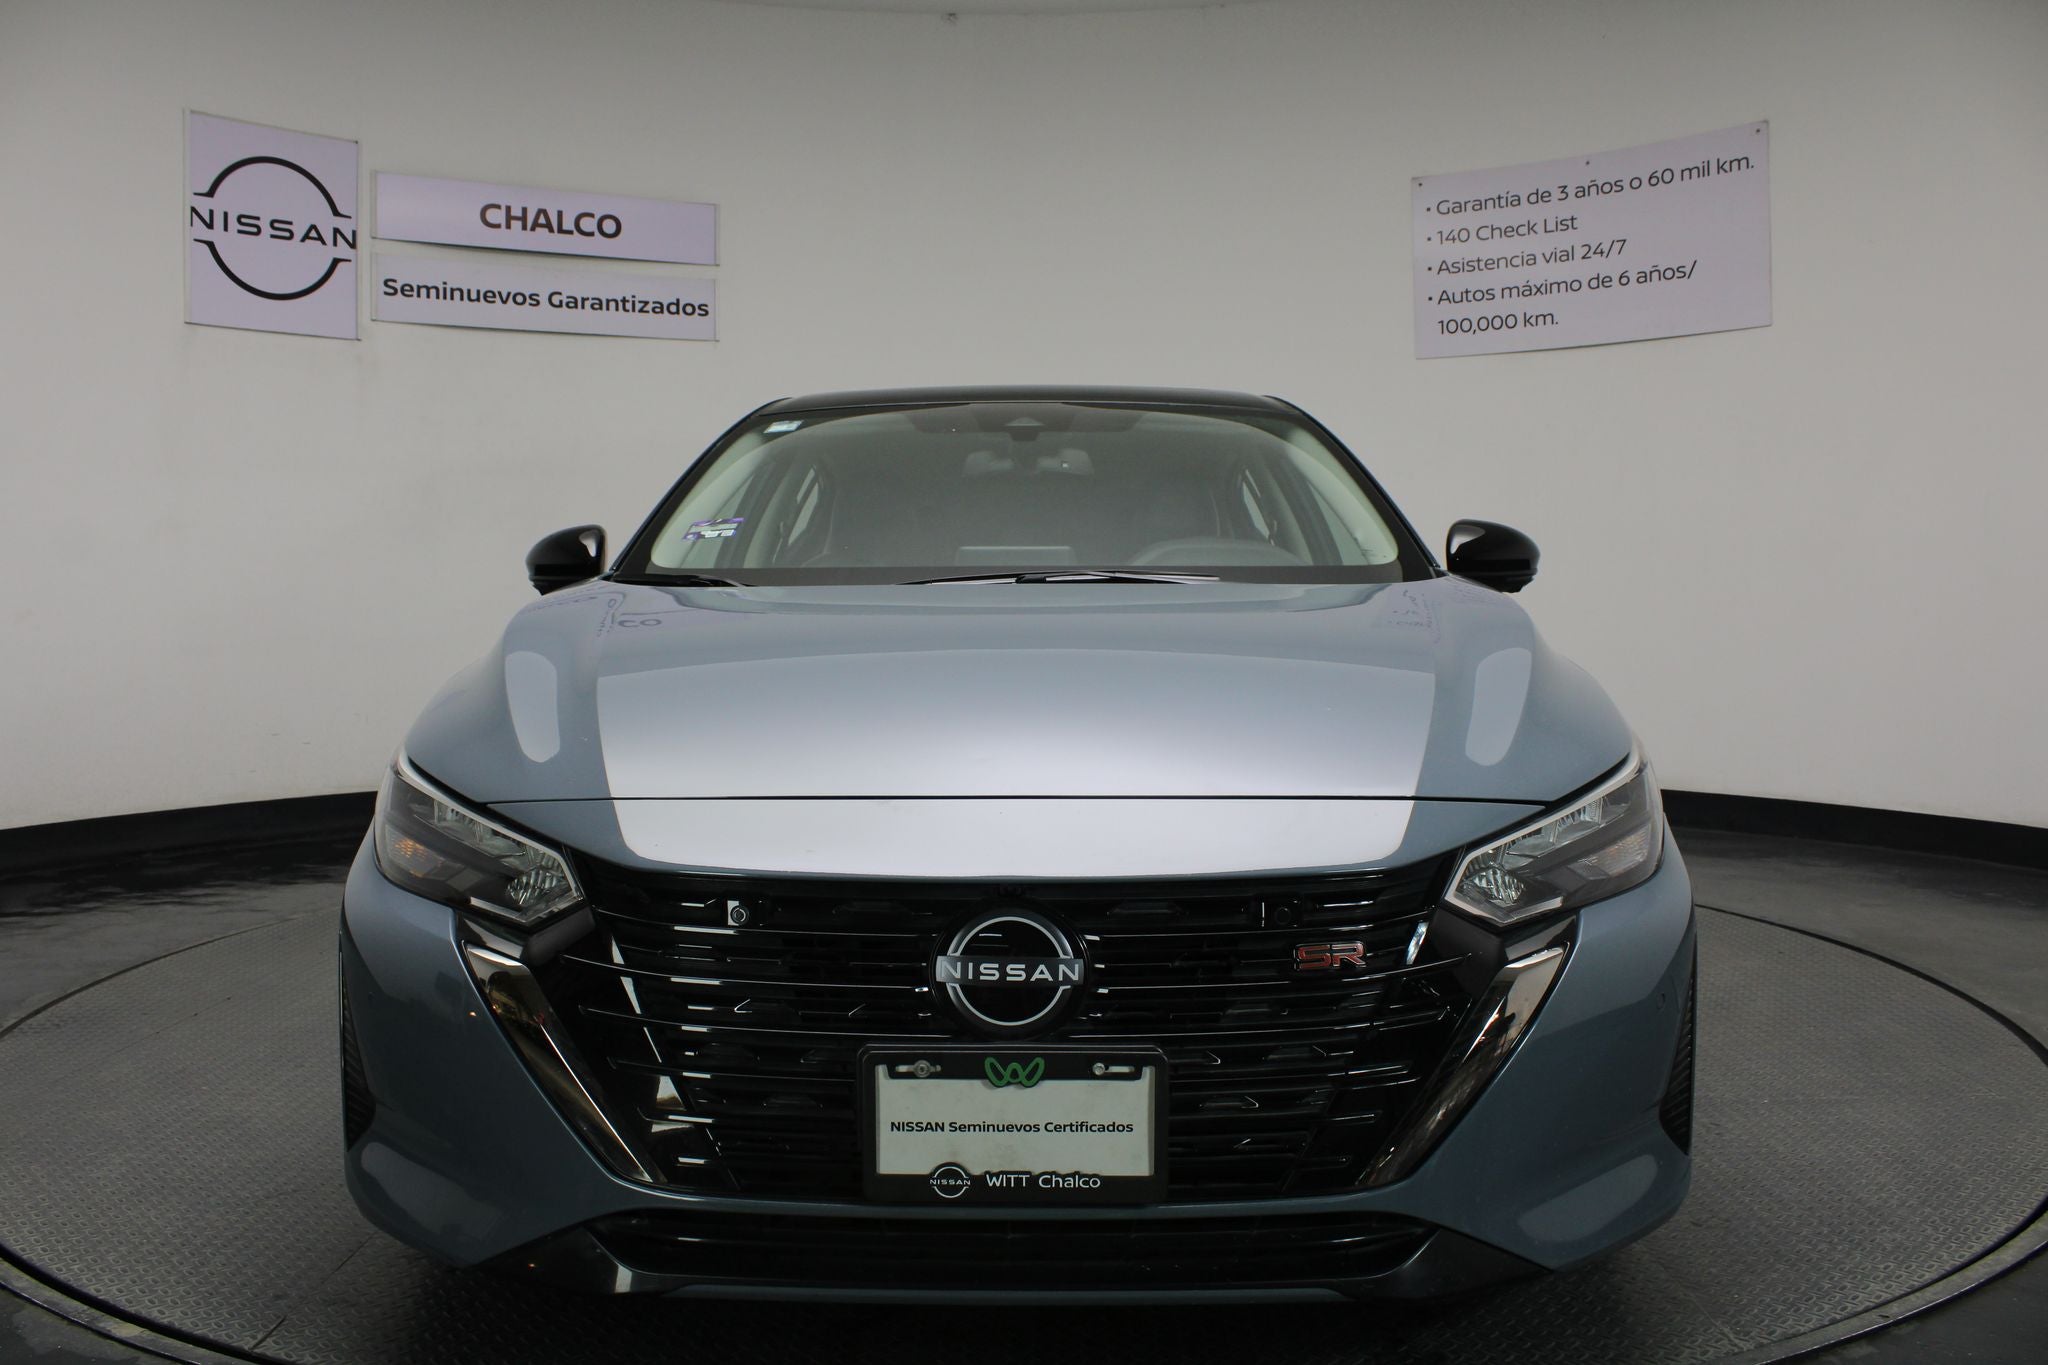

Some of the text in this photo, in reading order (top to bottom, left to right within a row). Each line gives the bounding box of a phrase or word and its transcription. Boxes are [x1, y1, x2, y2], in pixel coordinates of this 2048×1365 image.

[1436, 156, 1755, 216] Garantía de 3 años o 60 mil km.
[190, 206, 356, 249] NISSAN
[479, 204, 622, 238] CHALCO
[1437, 215, 1578, 245] 140 Check List
[1437, 239, 1627, 275] Asistencia vial 24/7
[1437, 260, 1697, 304] Autos máximo de 6 años/
[383, 278, 710, 318] Seminuevos Garantizados
[1438, 312, 1559, 336] 100,000 km.
[1296, 942, 1366, 969] SR
[940, 961, 1079, 982] NISSAN
[890, 1121, 1134, 1133] NISSAN Seminuevos Certificados
[929, 1178, 971, 1186] NISSAN
[985, 1174, 1100, 1188] WITT Chalco
